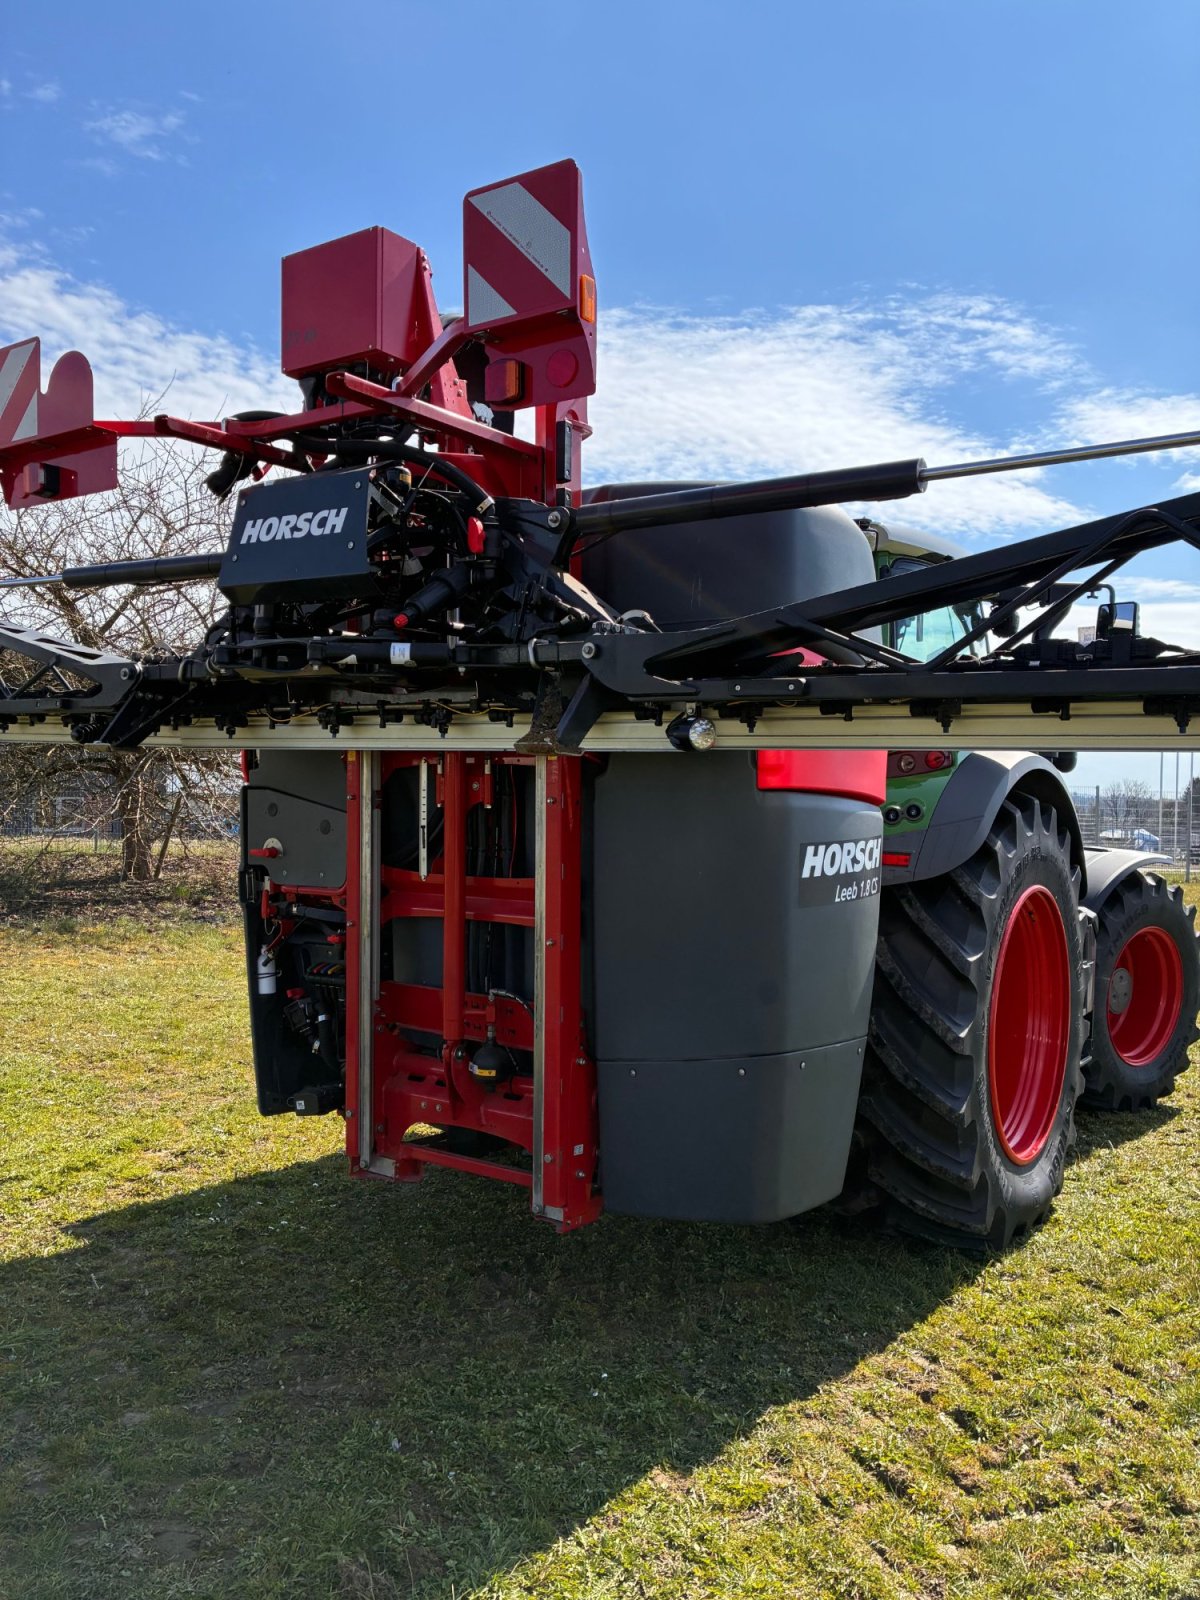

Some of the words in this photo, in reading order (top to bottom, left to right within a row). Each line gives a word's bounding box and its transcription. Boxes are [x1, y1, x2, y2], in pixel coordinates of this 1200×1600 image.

[240, 507, 348, 544] HORSCH
[801, 838, 882, 878] HORSCH
[835, 881, 858, 902] Leeb
[860, 879, 870, 898] 1.8
